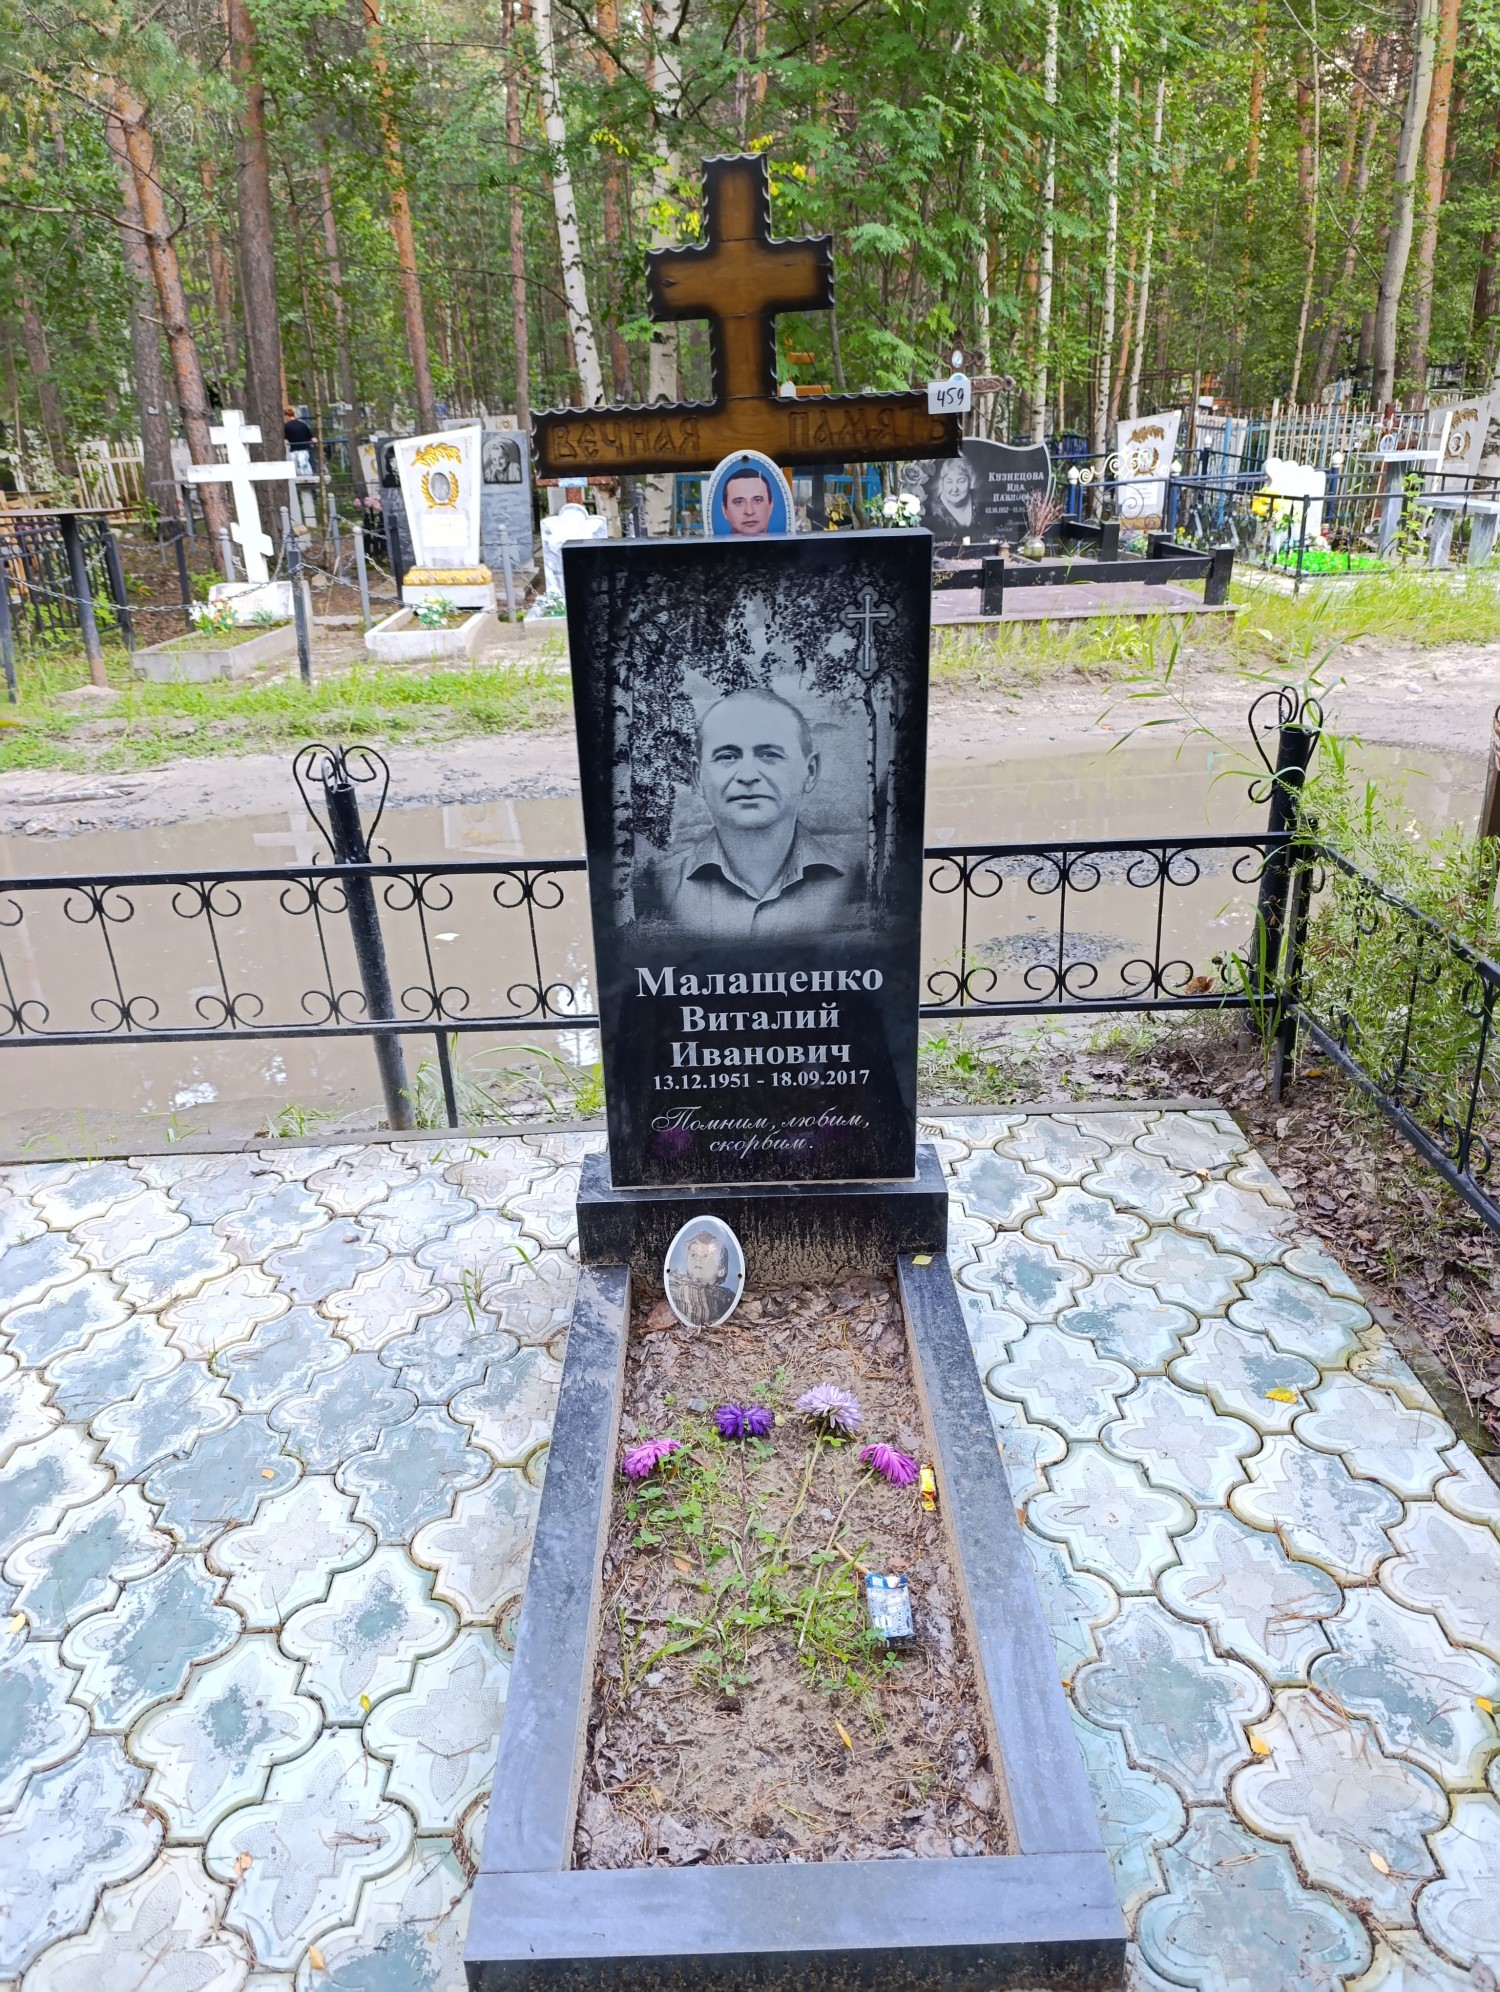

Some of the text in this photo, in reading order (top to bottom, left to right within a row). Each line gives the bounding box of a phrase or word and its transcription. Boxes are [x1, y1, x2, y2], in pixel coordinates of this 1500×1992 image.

[936, 386, 965, 408] 459
[634, 966, 883, 997] Малащенко
[679, 1002, 840, 1032] Виталий
[670, 1041, 851, 1068] Иванович
[653, 1074, 750, 1090] 13.12.1951
[771, 1069, 870, 1087] 18.09.2017
[651, 1105, 870, 1132] Помним, любим,
[709, 1129, 814, 1159] скорбим.
